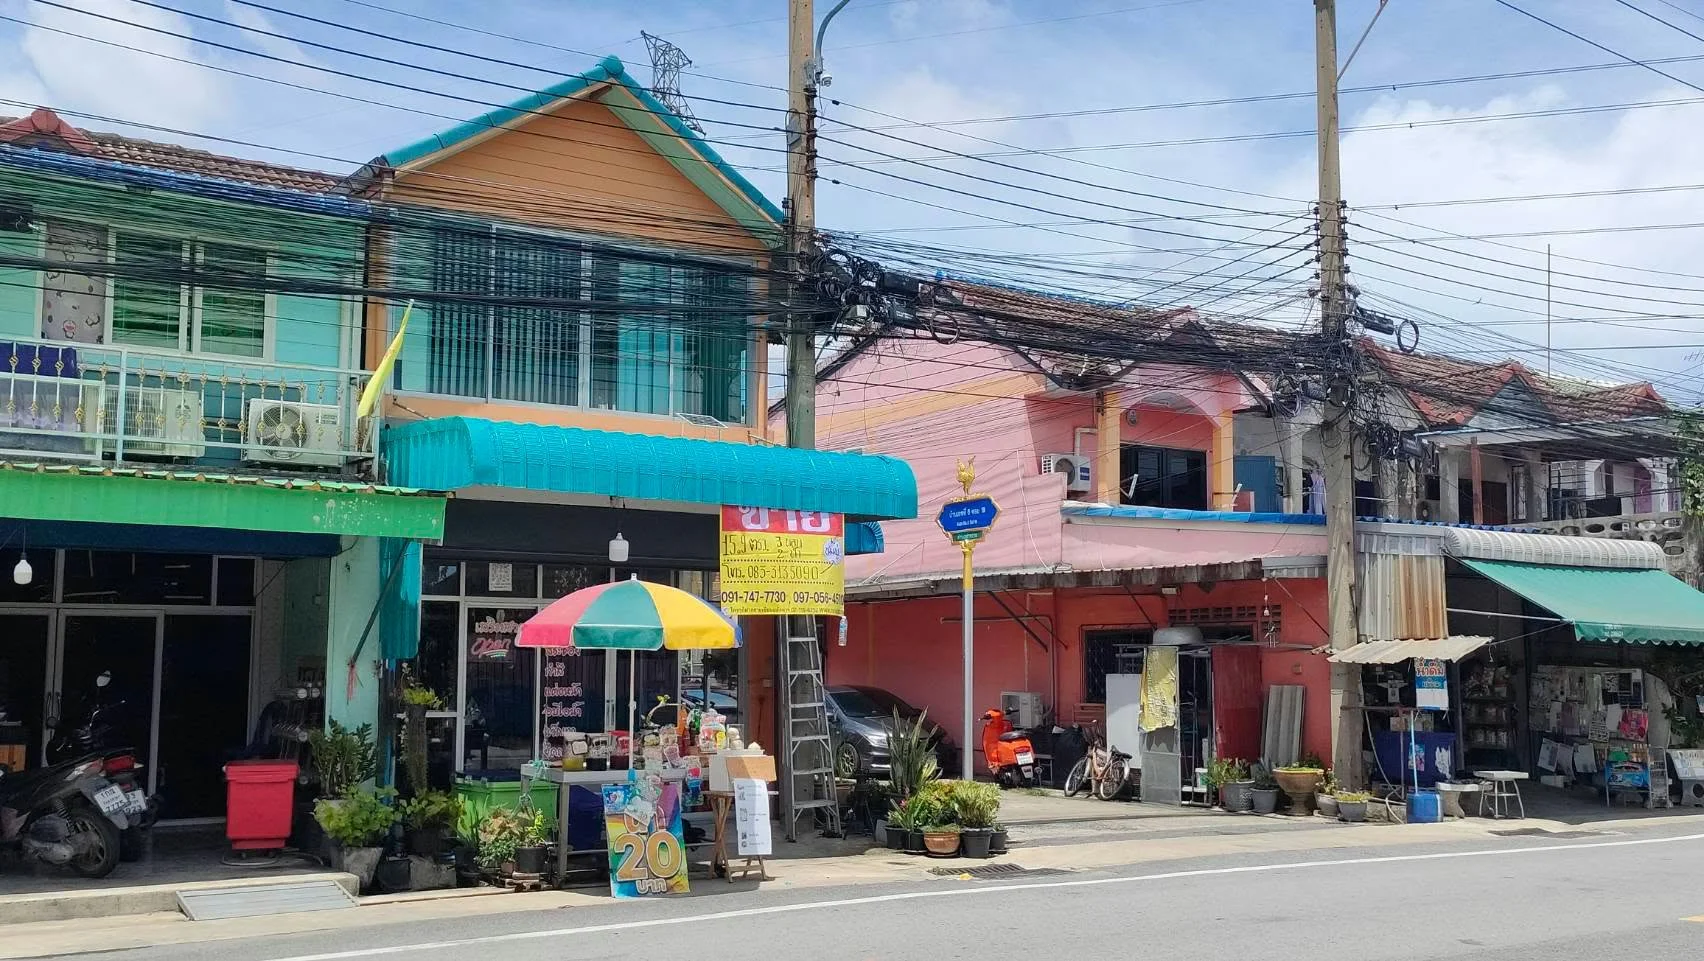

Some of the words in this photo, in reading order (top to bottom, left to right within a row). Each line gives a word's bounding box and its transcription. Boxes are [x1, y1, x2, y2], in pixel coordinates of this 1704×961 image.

[721, 591, 786, 603] 091-747-7730
[614, 831, 682, 880] 20
[635, 877, 667, 894] บาท
